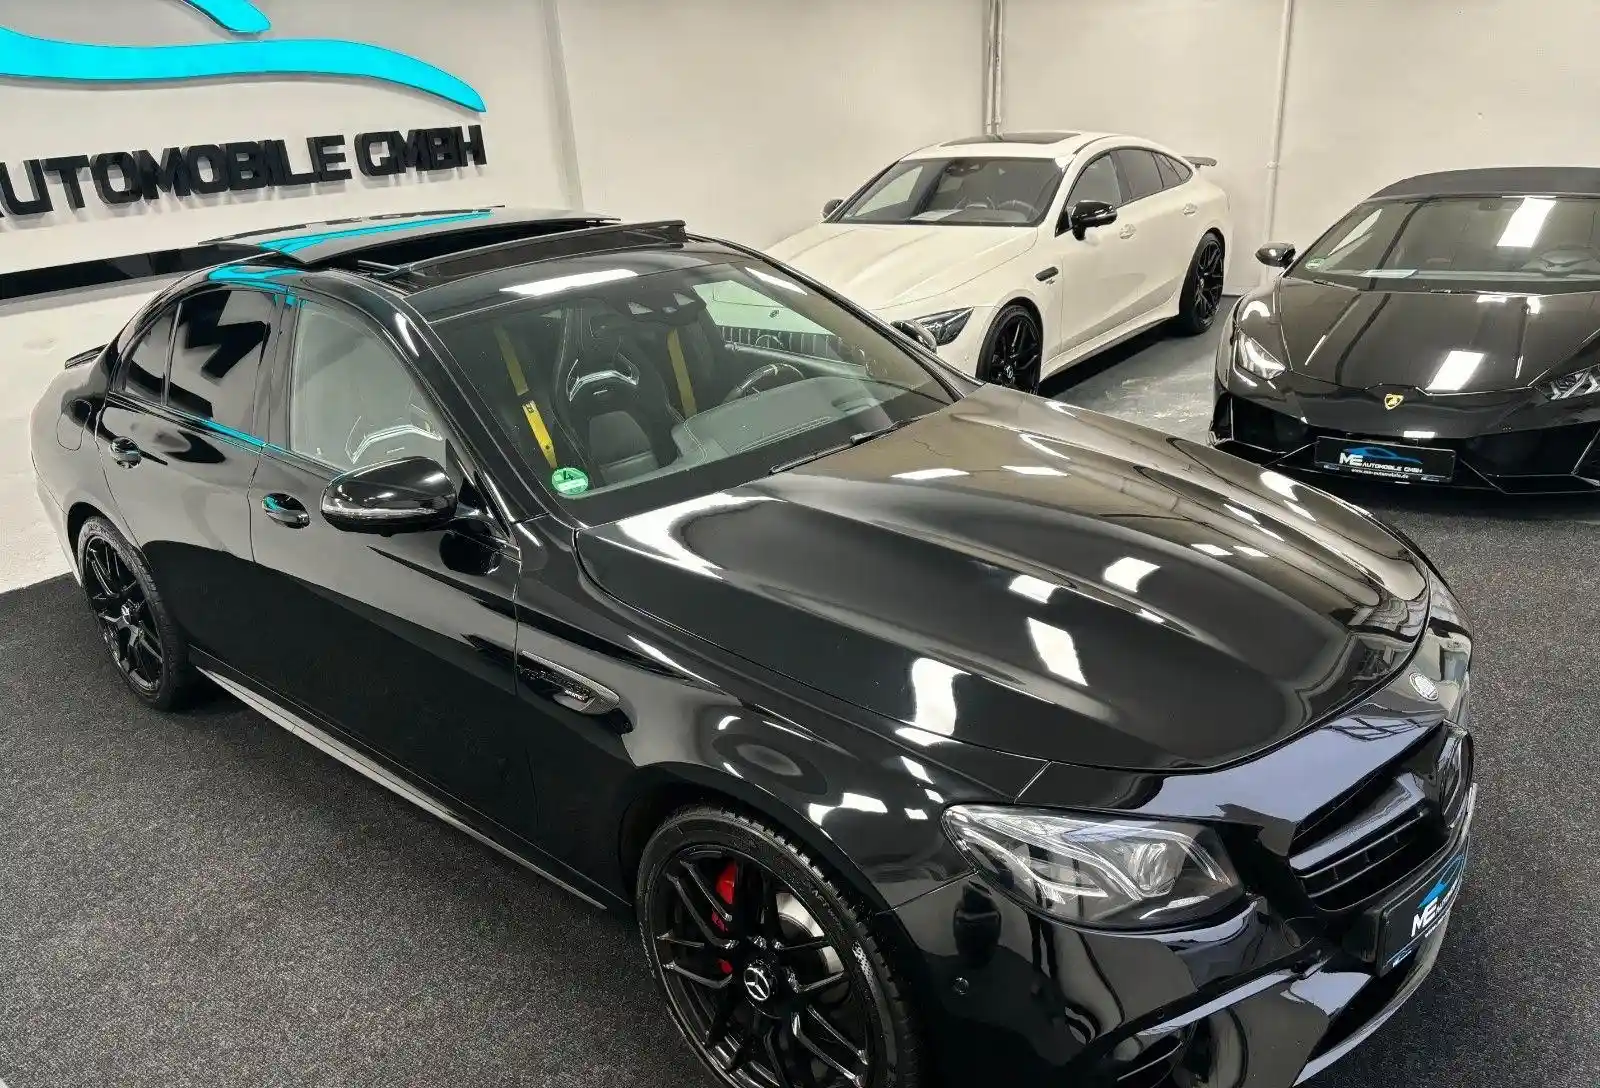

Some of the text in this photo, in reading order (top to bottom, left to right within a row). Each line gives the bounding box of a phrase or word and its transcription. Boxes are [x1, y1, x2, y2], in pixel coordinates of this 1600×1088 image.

[0, 125, 487, 217] UTOMOBILE GMBH
[1339, 452, 1364, 467] ME
